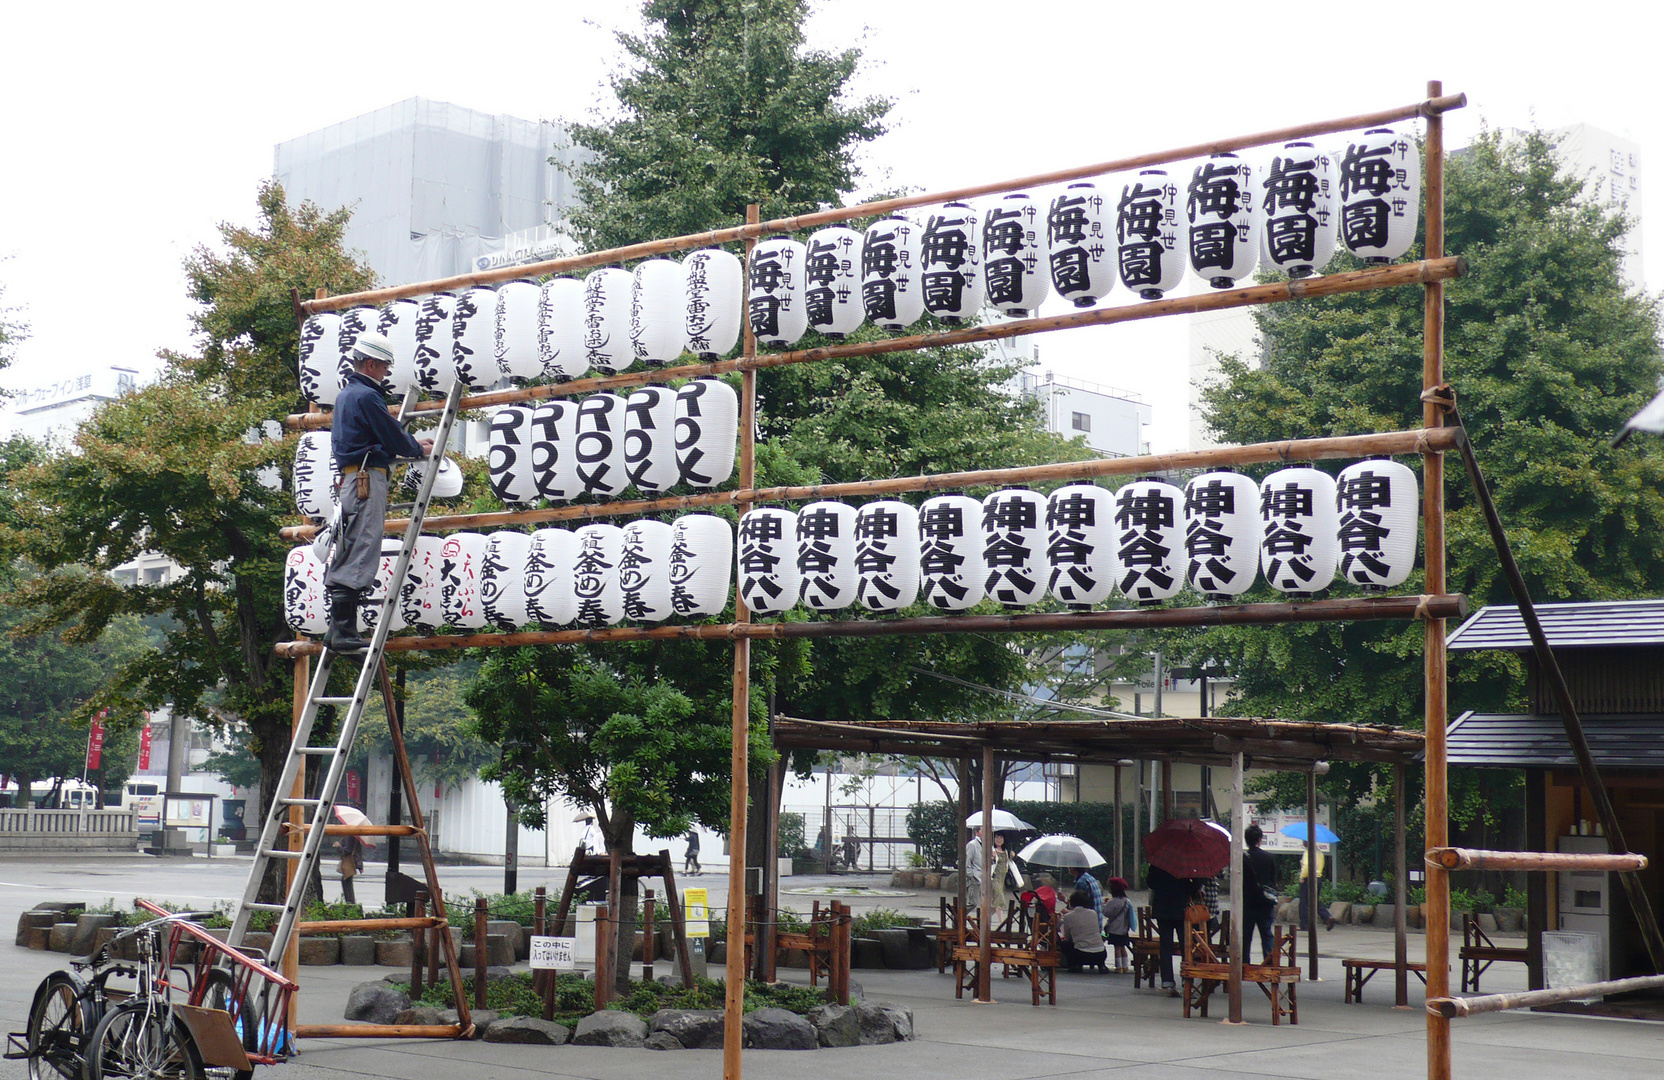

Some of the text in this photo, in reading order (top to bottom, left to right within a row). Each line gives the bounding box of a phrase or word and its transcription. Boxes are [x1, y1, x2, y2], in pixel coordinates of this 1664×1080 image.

[1160, 183, 1178, 250] 仲見世
[1187, 163, 1240, 271] 梅園
[1236, 164, 1252, 242] 仲見世
[1263, 156, 1318, 265] 梅園
[1315, 155, 1331, 227] 仲見世
[1339, 143, 1395, 251] 梅園
[1390, 140, 1411, 217] 仲見世
[837, 236, 854, 304] 仲見世
[895, 226, 912, 292] 仲見世
[921, 215, 968, 313] 梅園
[964, 215, 979, 289] 仲見世
[983, 208, 1024, 306] 梅園
[1021, 206, 1038, 274] 仲見世
[1048, 196, 1090, 292] 梅園
[1087, 195, 1105, 263] 仲見世
[1116, 182, 1164, 289] 梅園
[749, 250, 781, 336] 梅園
[780, 247, 794, 311] 仲見世
[806, 240, 839, 325] 梅園
[861, 230, 897, 320] 梅園
[300, 314, 324, 403] 浅草今半
[413, 295, 449, 390] 浅草今半
[452, 292, 478, 385] 浅草今半
[489, 409, 524, 500] ROX
[532, 404, 565, 498] ROX
[576, 396, 614, 492] ROX
[624, 389, 660, 489] ROX
[674, 382, 712, 484] ROX
[285, 567, 312, 632] 大黒家
[302, 562, 318, 620] 天ぷら
[420, 551, 434, 610] 天ぷら
[440, 558, 466, 627] 大黒家
[458, 552, 474, 616] 天ぷら
[534, 941, 570, 949] この中に
